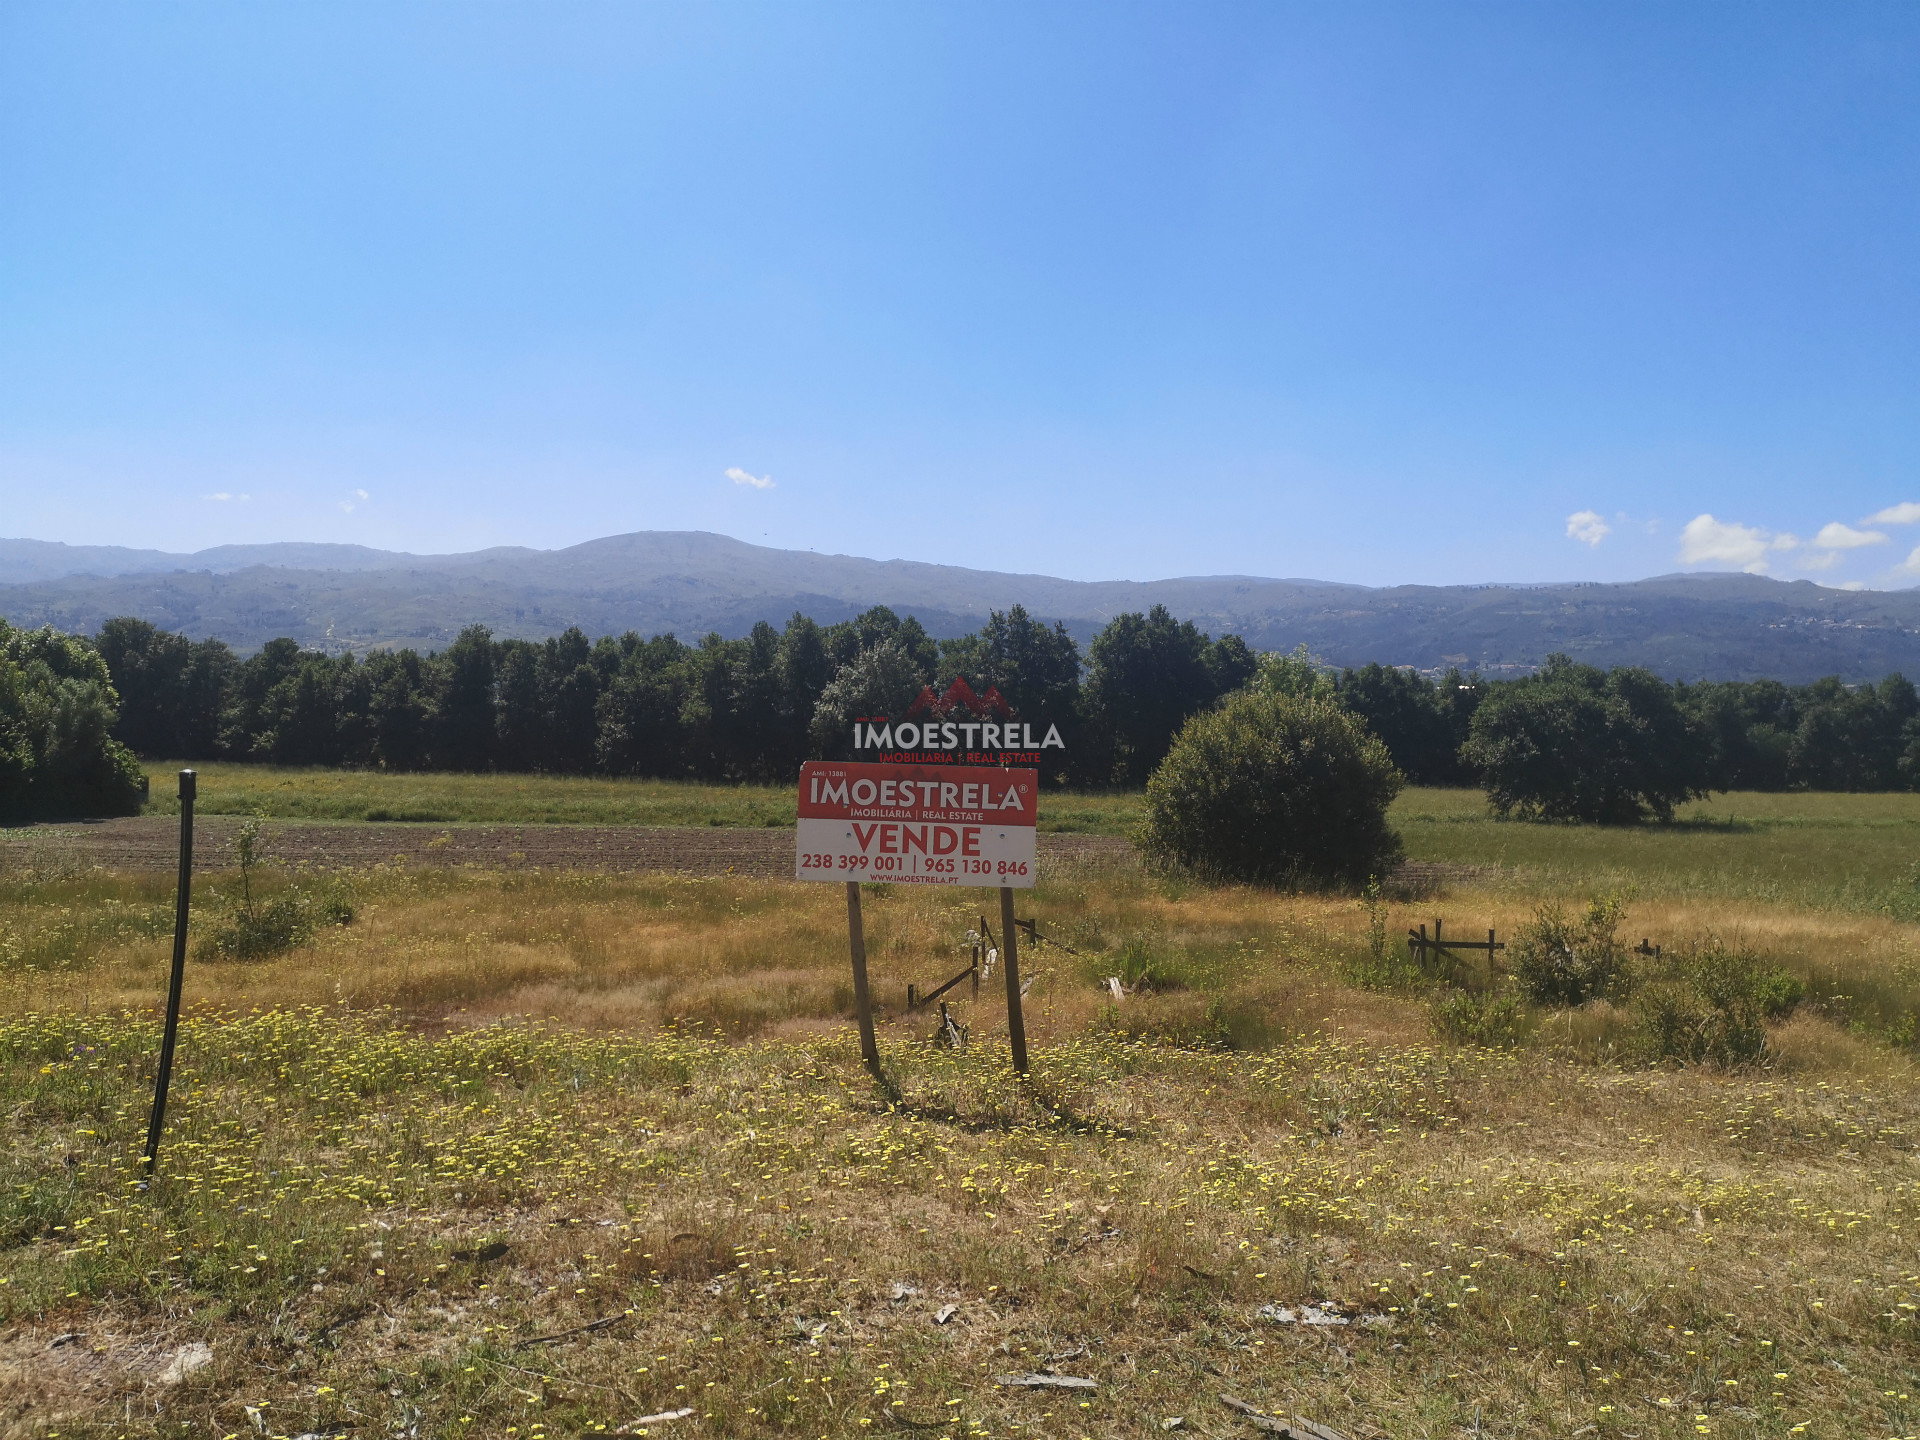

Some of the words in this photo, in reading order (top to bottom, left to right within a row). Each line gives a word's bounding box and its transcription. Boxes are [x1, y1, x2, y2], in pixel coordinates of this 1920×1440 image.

[851, 807, 911, 818] IMOBILIÁRIA
[922, 811, 946, 820] REAL
[949, 812, 983, 821] ESTATE
[852, 823, 981, 856] VENDE
[802, 854, 832, 868] 238
[838, 855, 868, 870] 399
[875, 856, 903, 870] 001
[924, 858, 955, 872] 965
[963, 860, 991, 874] 130
[998, 861, 1028, 875] 846
[870, 874, 959, 884] WWW.IMOESTRELA.PT
